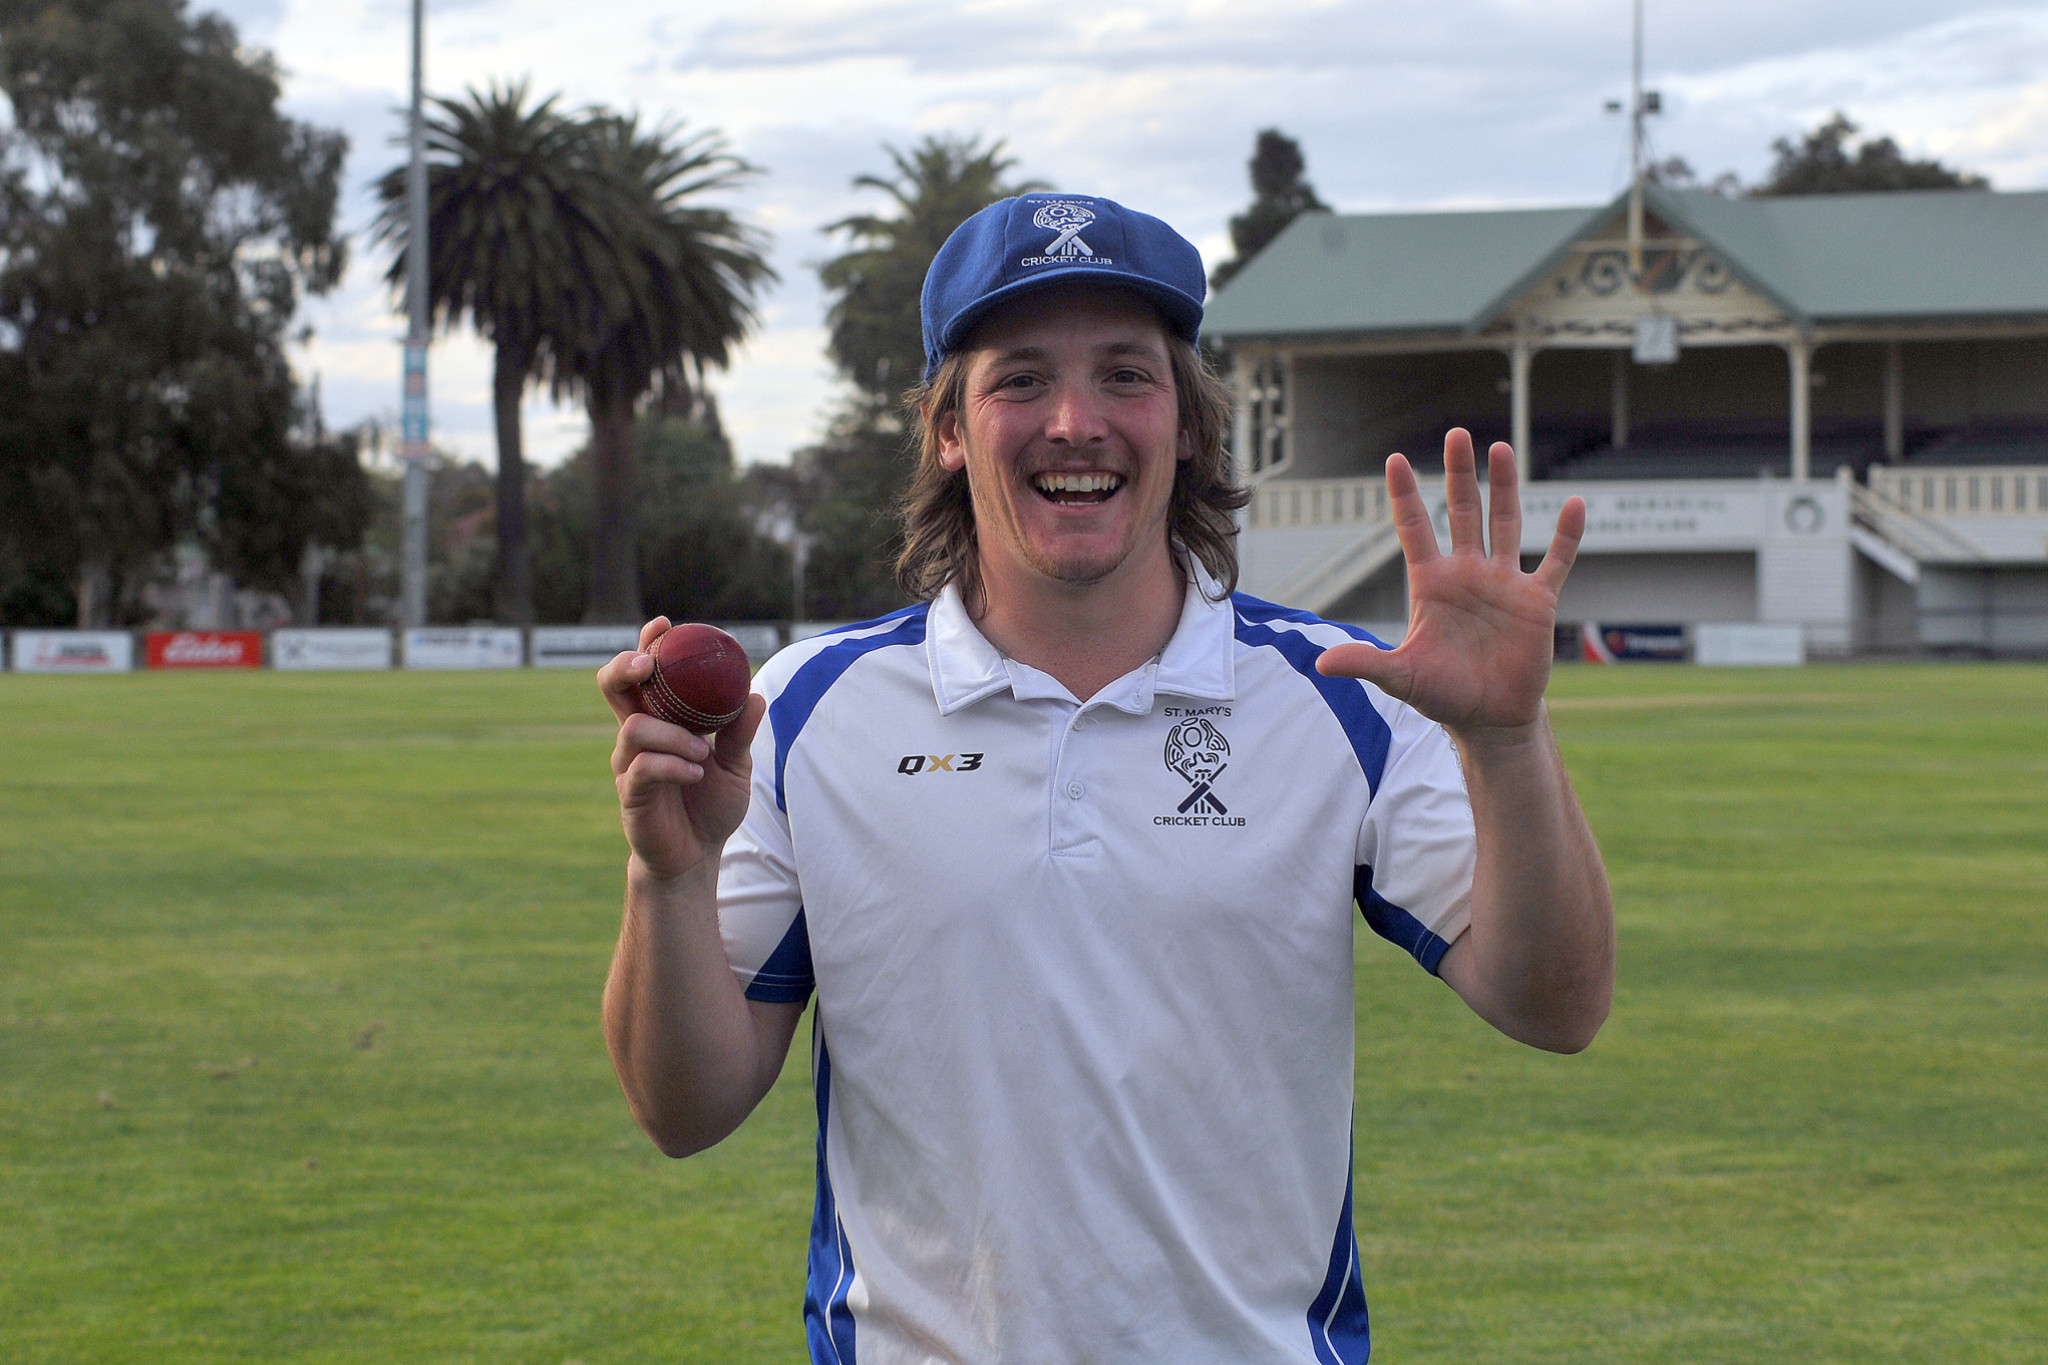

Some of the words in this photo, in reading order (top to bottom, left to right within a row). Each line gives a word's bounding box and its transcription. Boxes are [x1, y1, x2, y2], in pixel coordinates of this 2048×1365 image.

[1021, 256, 1076, 267] CRICKET
[1078, 256, 1113, 265] CLUB
[1164, 707, 1183, 717] ST.
[1185, 706, 1232, 717] MARY'S
[897, 752, 985, 776] QX3
[1153, 816, 1209, 826] CRICKET
[1211, 816, 1247, 827] CLUB
